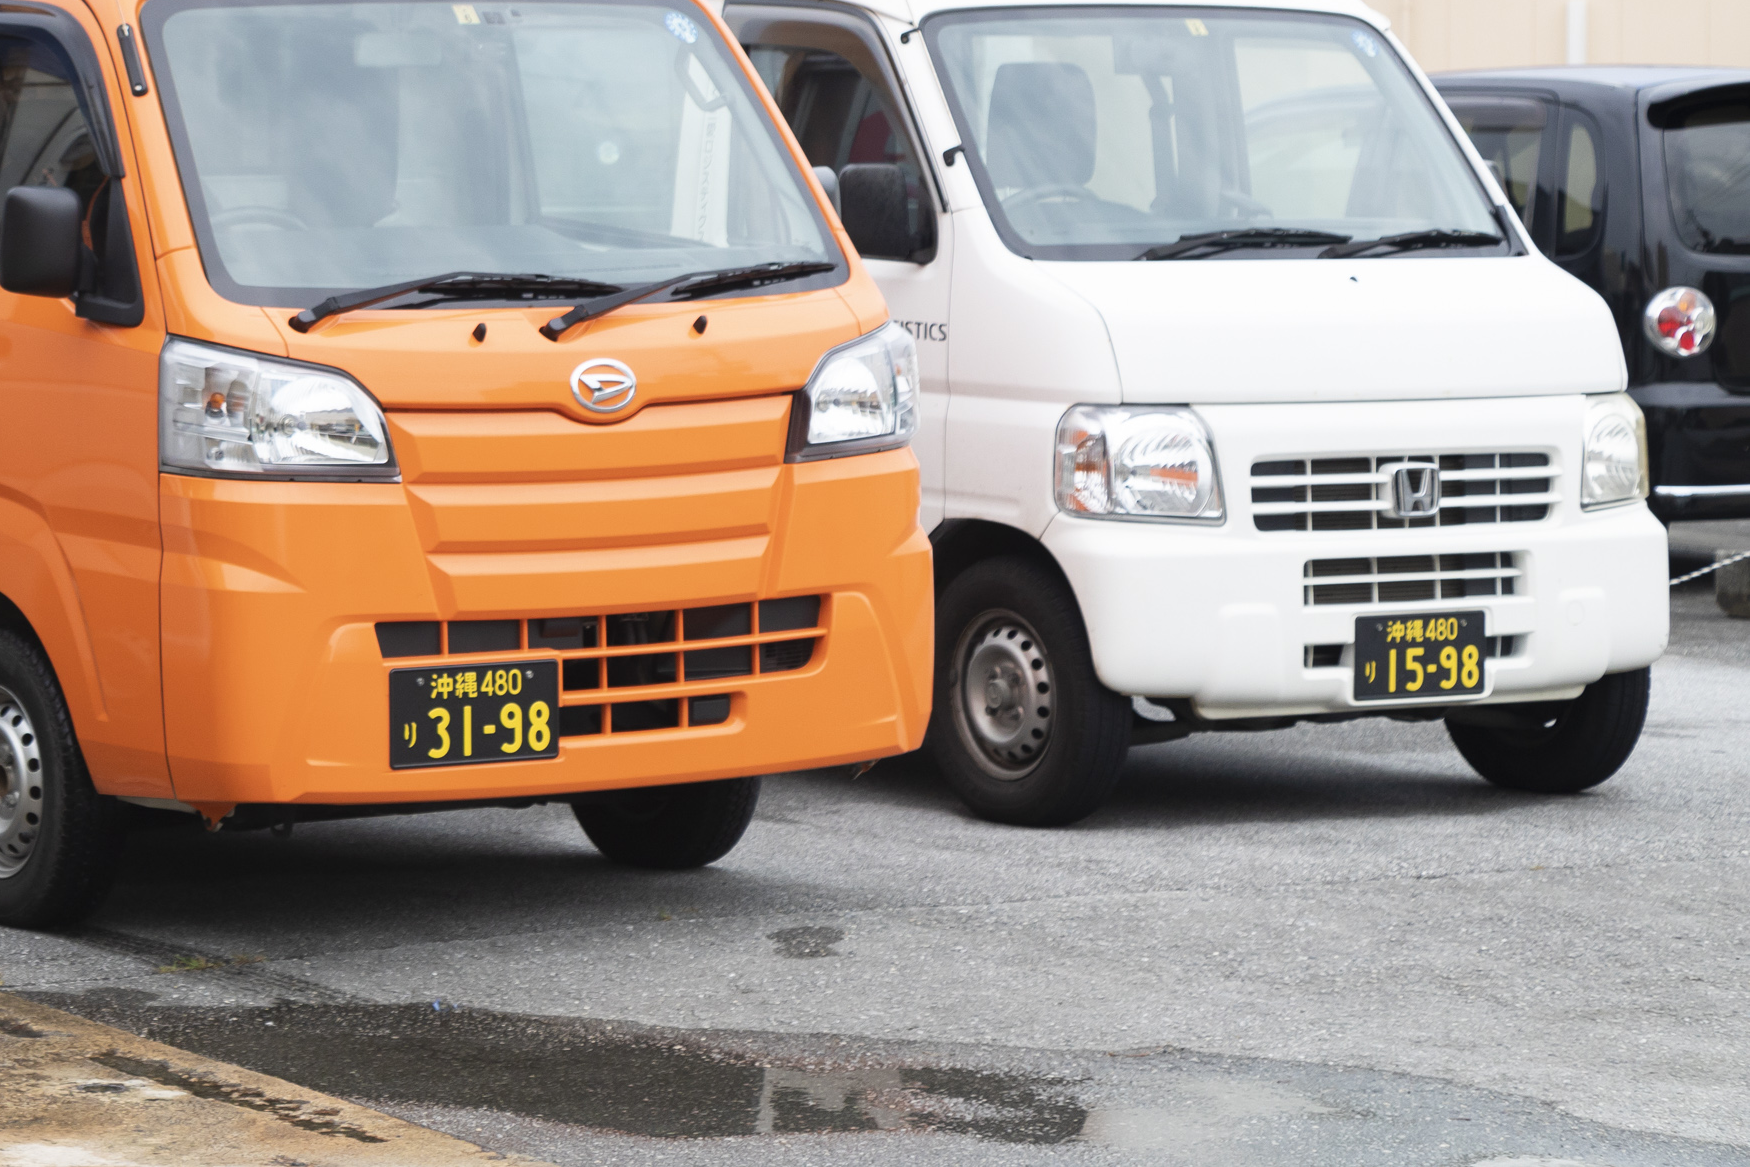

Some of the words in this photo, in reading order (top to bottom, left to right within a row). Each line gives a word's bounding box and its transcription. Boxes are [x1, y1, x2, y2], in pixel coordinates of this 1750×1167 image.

[1364, 660, 1376, 684] り
[1388, 644, 1480, 693] 15-98
[403, 721, 418, 748] り
[427, 700, 551, 759] 31-98
